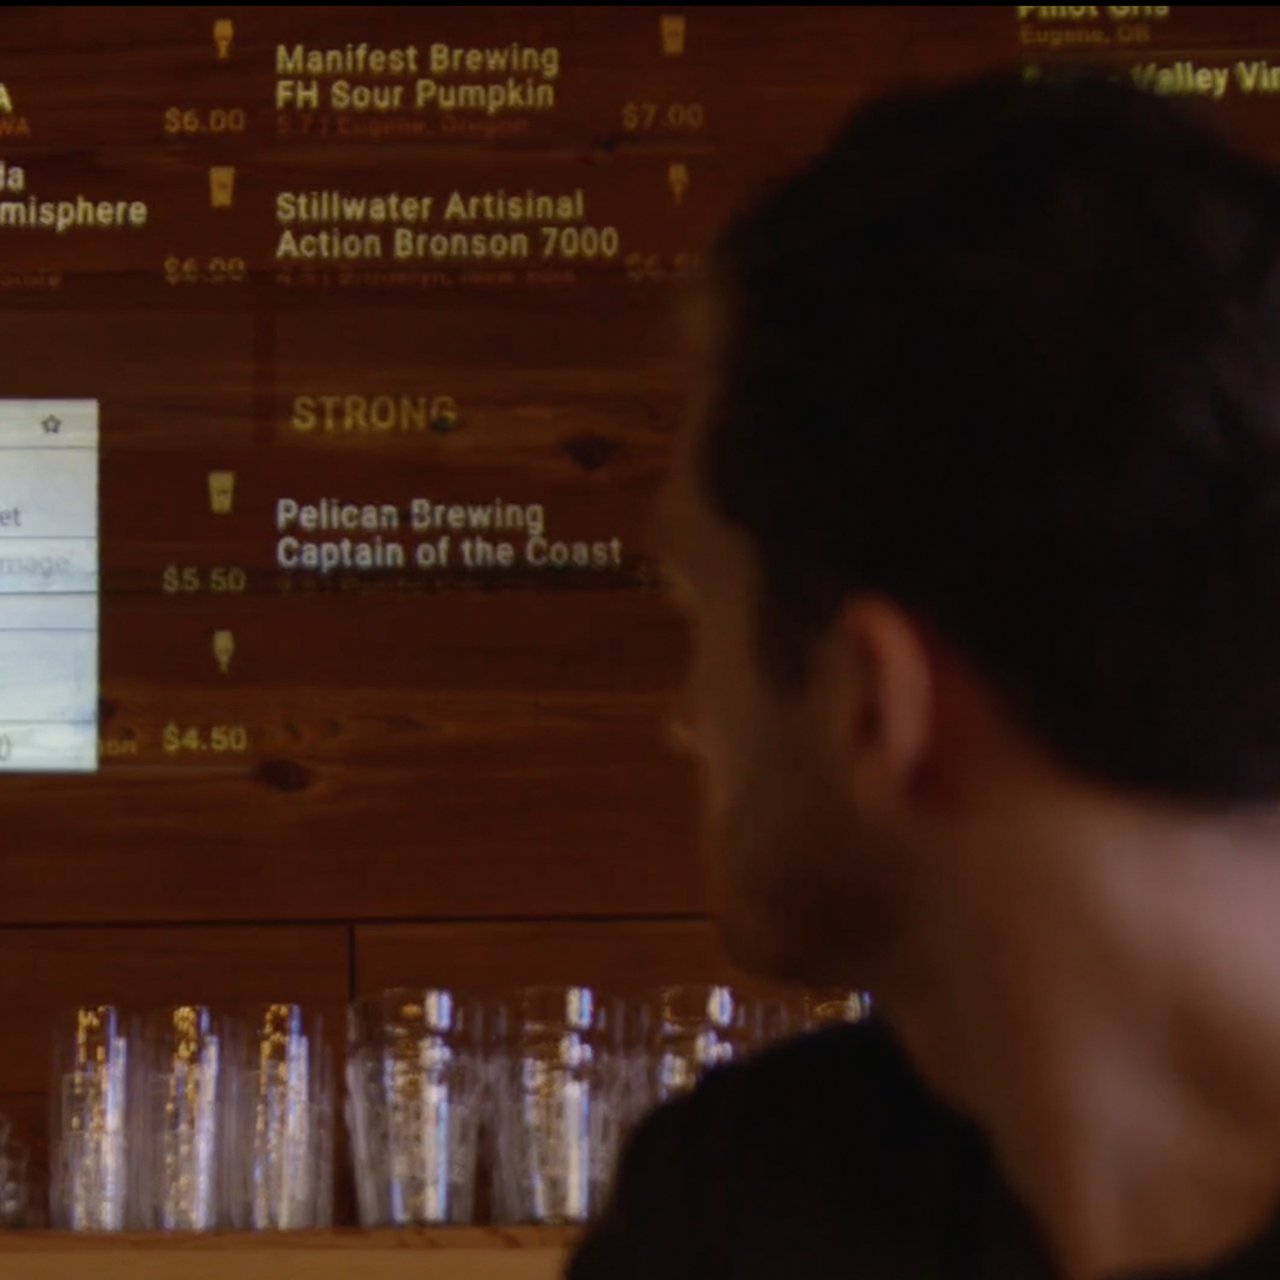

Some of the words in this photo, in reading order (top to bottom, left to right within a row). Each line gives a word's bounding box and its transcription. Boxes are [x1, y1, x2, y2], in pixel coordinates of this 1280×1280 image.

[276, 44, 417, 74] Manifest
[430, 43, 560, 79] Brewing
[276, 80, 318, 109] FH
[331, 80, 404, 109] Sour
[416, 80, 556, 115] Pumpkin
[164, 108, 244, 134] $6.00
[622, 103, 703, 130] $7.00
[276, 192, 434, 221] Stillwater
[444, 189, 584, 221] Artisinal
[276, 228, 382, 259] Action
[394, 228, 528, 258] Bronson
[542, 226, 619, 257] 7000
[290, 394, 460, 432] STRONG
[276, 498, 399, 530] Pelican
[410, 498, 545, 536] Brewing
[276, 536, 405, 573] Captain
[416, 536, 451, 567] of
[462, 536, 514, 566] the
[525, 535, 622, 566] Coast
[163, 565, 245, 593] $5.50
[162, 723, 247, 752] $4.50
